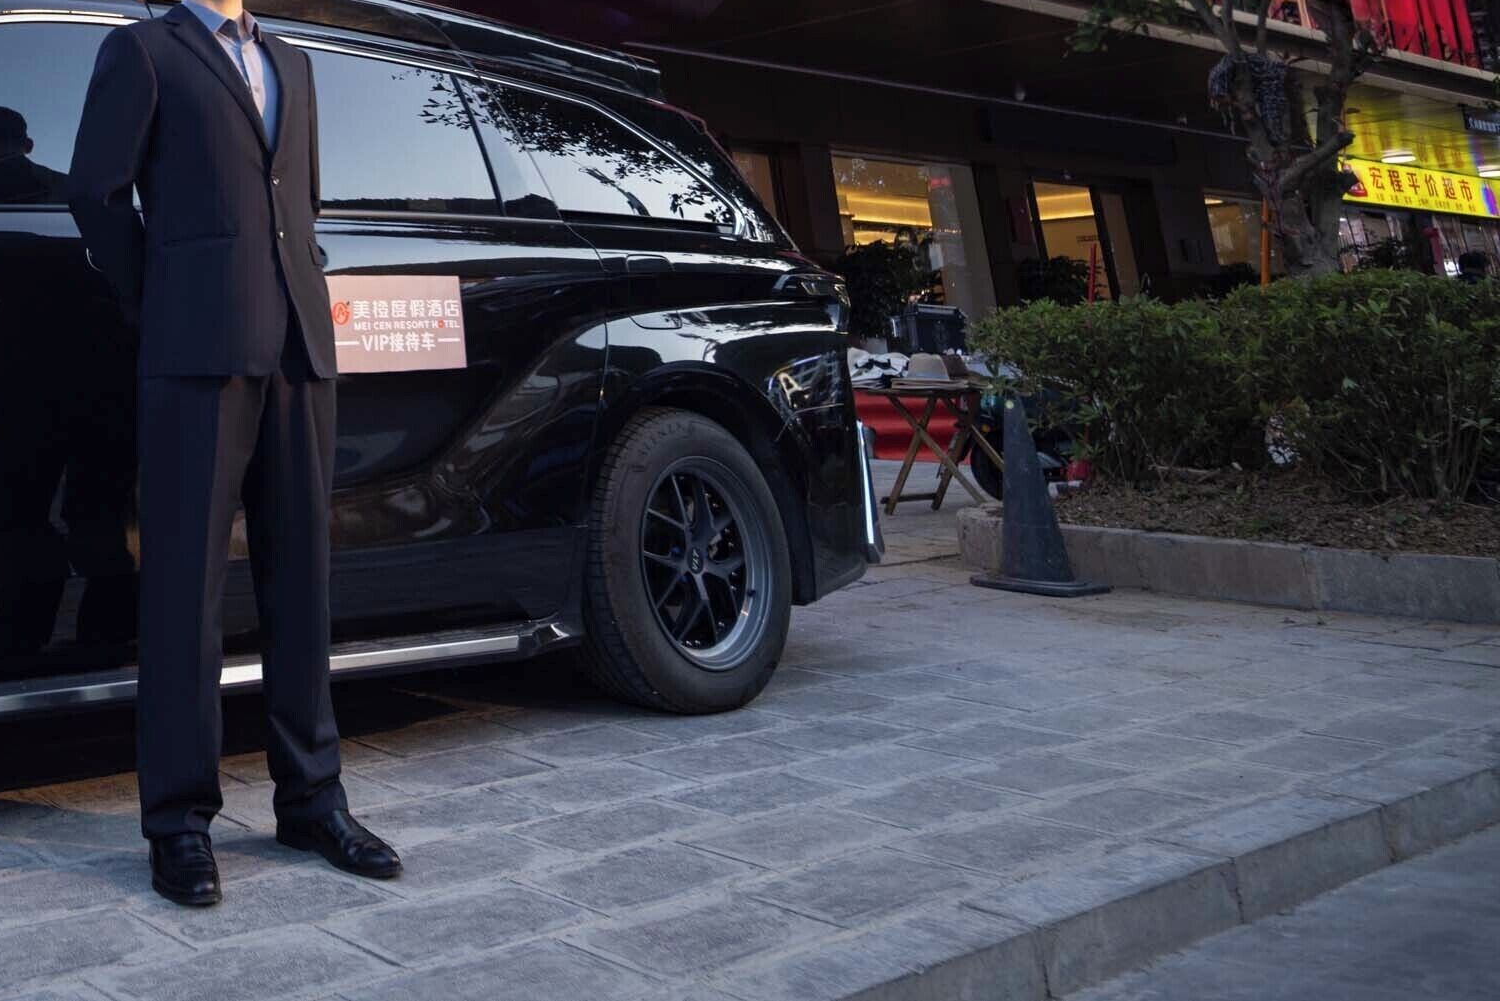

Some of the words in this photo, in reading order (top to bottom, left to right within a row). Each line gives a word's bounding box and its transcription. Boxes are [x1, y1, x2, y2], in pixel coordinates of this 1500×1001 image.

[1368, 166, 1474, 202] 宏程平价超市
[353, 300, 460, 319] 美橙度假酒店
[354, 321, 371, 331] MEI
[373, 320, 392, 330] CEN
[394, 320, 429, 329] RESORT
[431, 319, 461, 329] HOTEL
[362, 332, 437, 352] VIP接待车
